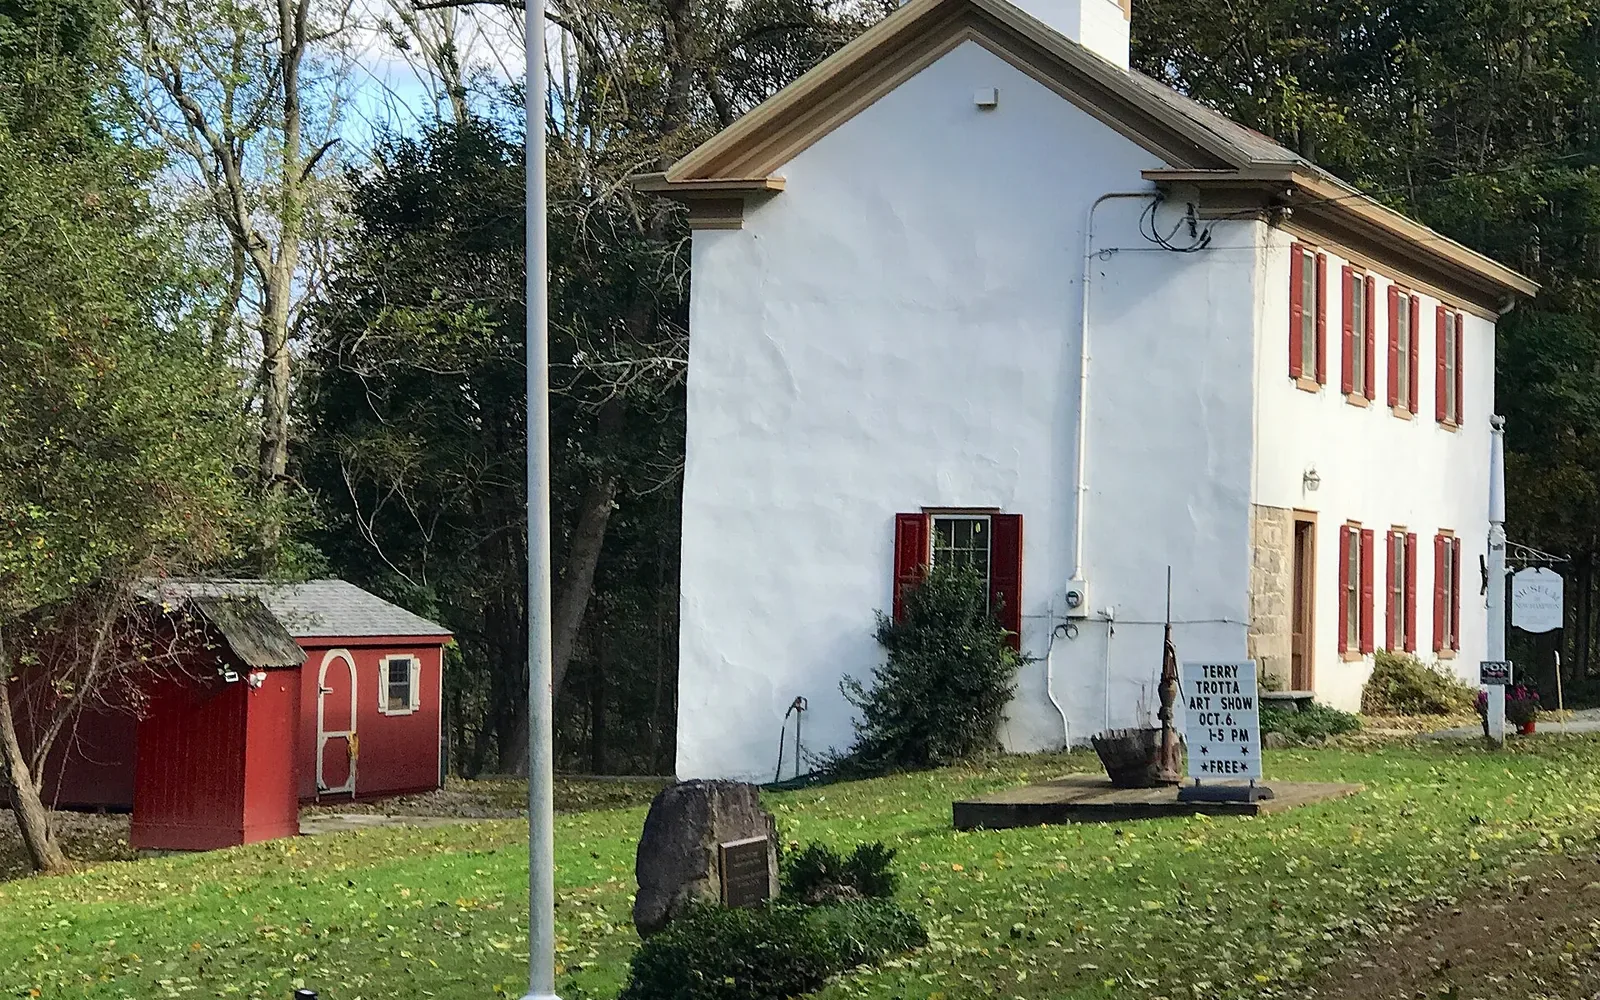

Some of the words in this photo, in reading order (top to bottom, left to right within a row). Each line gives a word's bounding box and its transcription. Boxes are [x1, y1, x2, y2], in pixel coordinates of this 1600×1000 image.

[1202, 665, 1239, 678] TERRY
[1482, 663, 1509, 671] FOX
[1196, 681, 1240, 695] TROTTA
[1189, 696, 1211, 710] ART
[1220, 697, 1253, 710] SHOW
[1208, 728, 1225, 742] 1-5
[1231, 729, 1250, 742] PM
[1209, 760, 1239, 774] FREE
